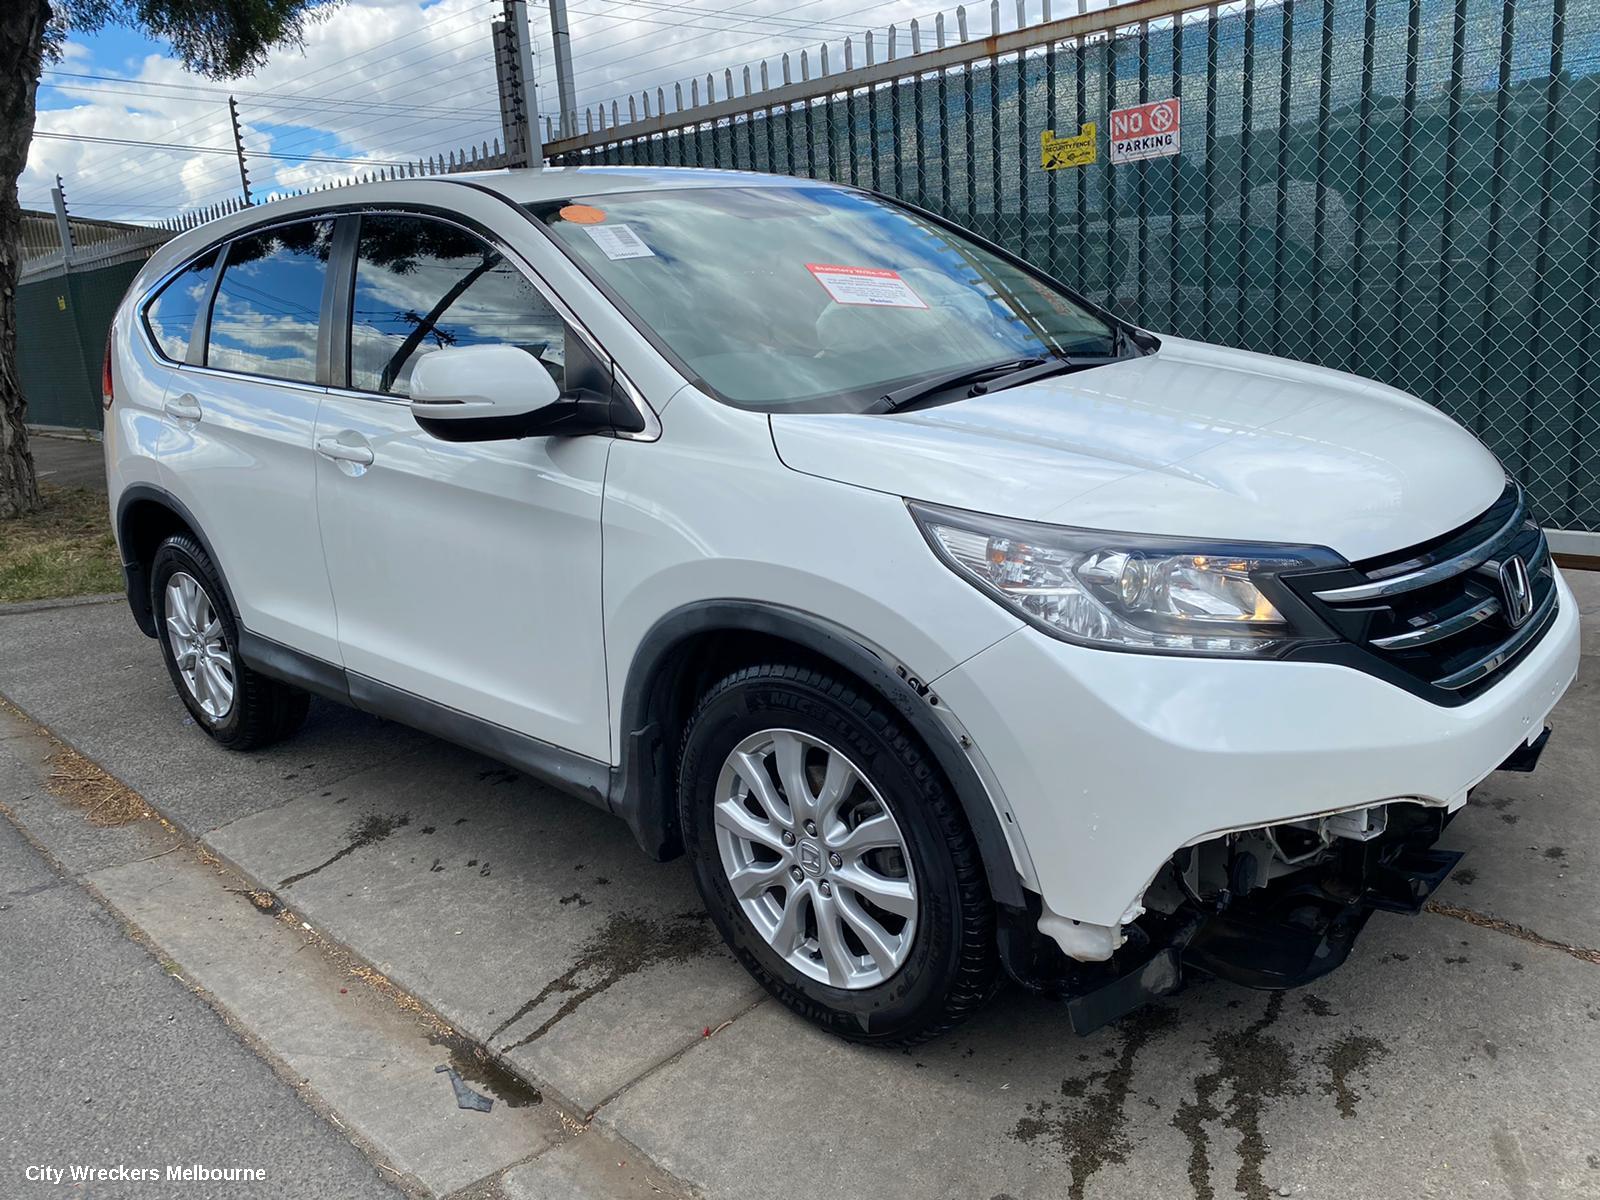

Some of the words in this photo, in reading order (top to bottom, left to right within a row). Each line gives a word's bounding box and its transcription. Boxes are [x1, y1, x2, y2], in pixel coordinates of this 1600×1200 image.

[1115, 113, 1143, 136] NO
[1045, 143, 1072, 152] SECURITY
[1072, 140, 1091, 149] FENCE
[1118, 134, 1173, 154] PARKING
